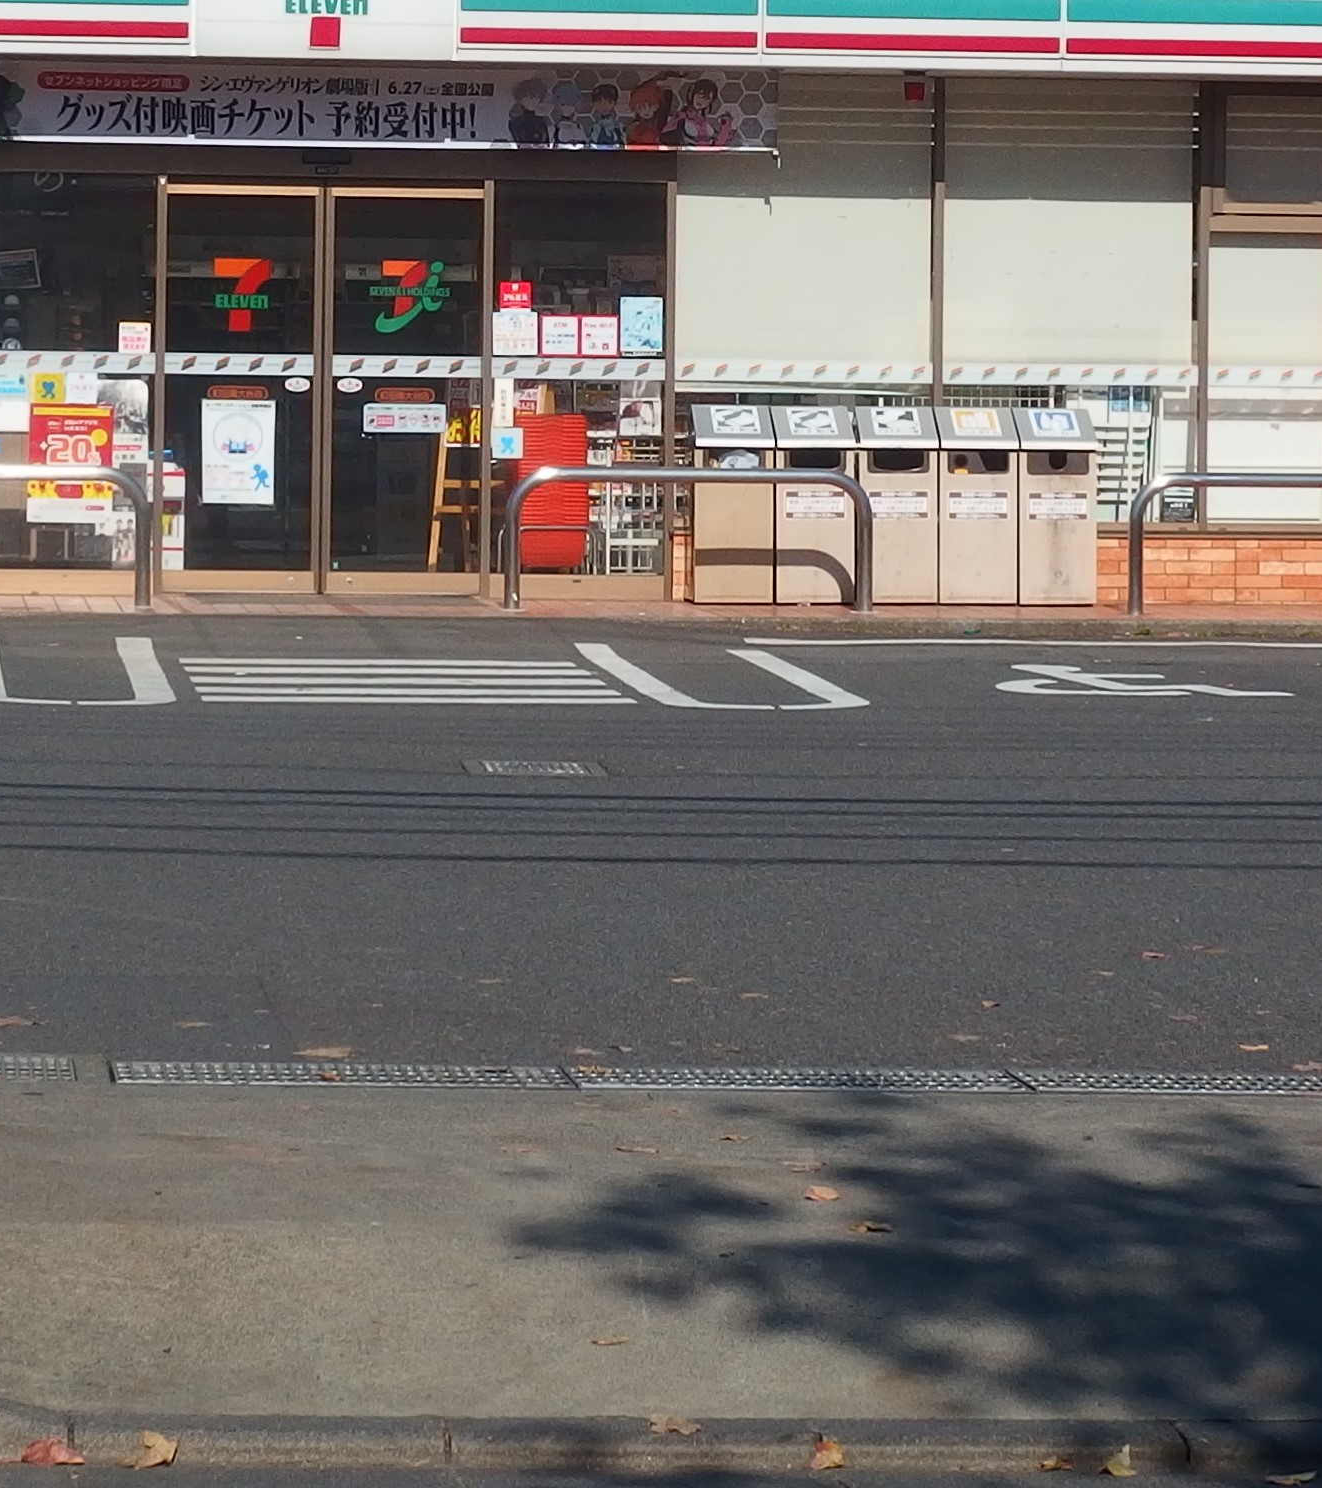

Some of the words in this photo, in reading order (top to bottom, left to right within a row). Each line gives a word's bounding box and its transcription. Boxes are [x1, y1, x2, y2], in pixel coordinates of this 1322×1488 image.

[57, 95, 317, 138] グッズ付映画チケット
